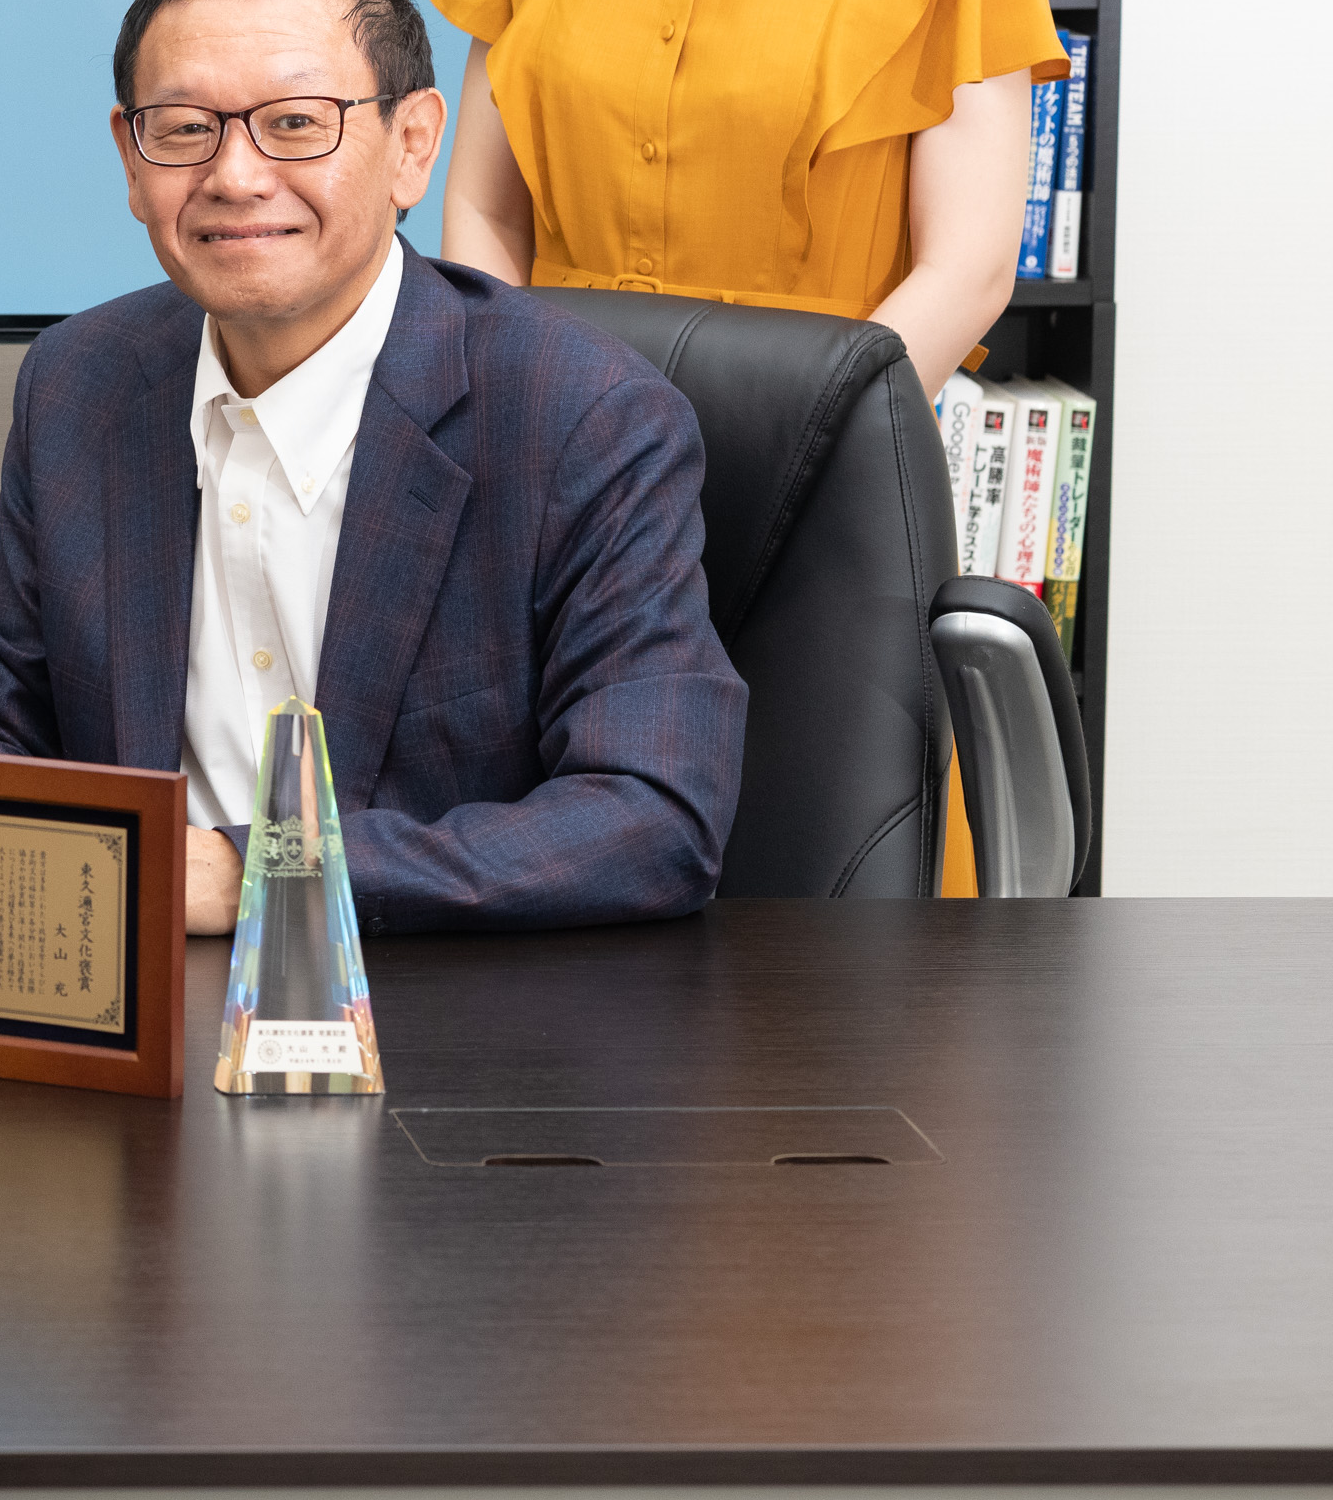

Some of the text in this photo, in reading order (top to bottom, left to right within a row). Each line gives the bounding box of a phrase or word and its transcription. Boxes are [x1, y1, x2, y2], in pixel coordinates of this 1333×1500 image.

[1066, 44, 1087, 127] THE TEAM
[986, 445, 1006, 507] 高勝率
[1015, 448, 1044, 581] 魔術師たちの心理学
